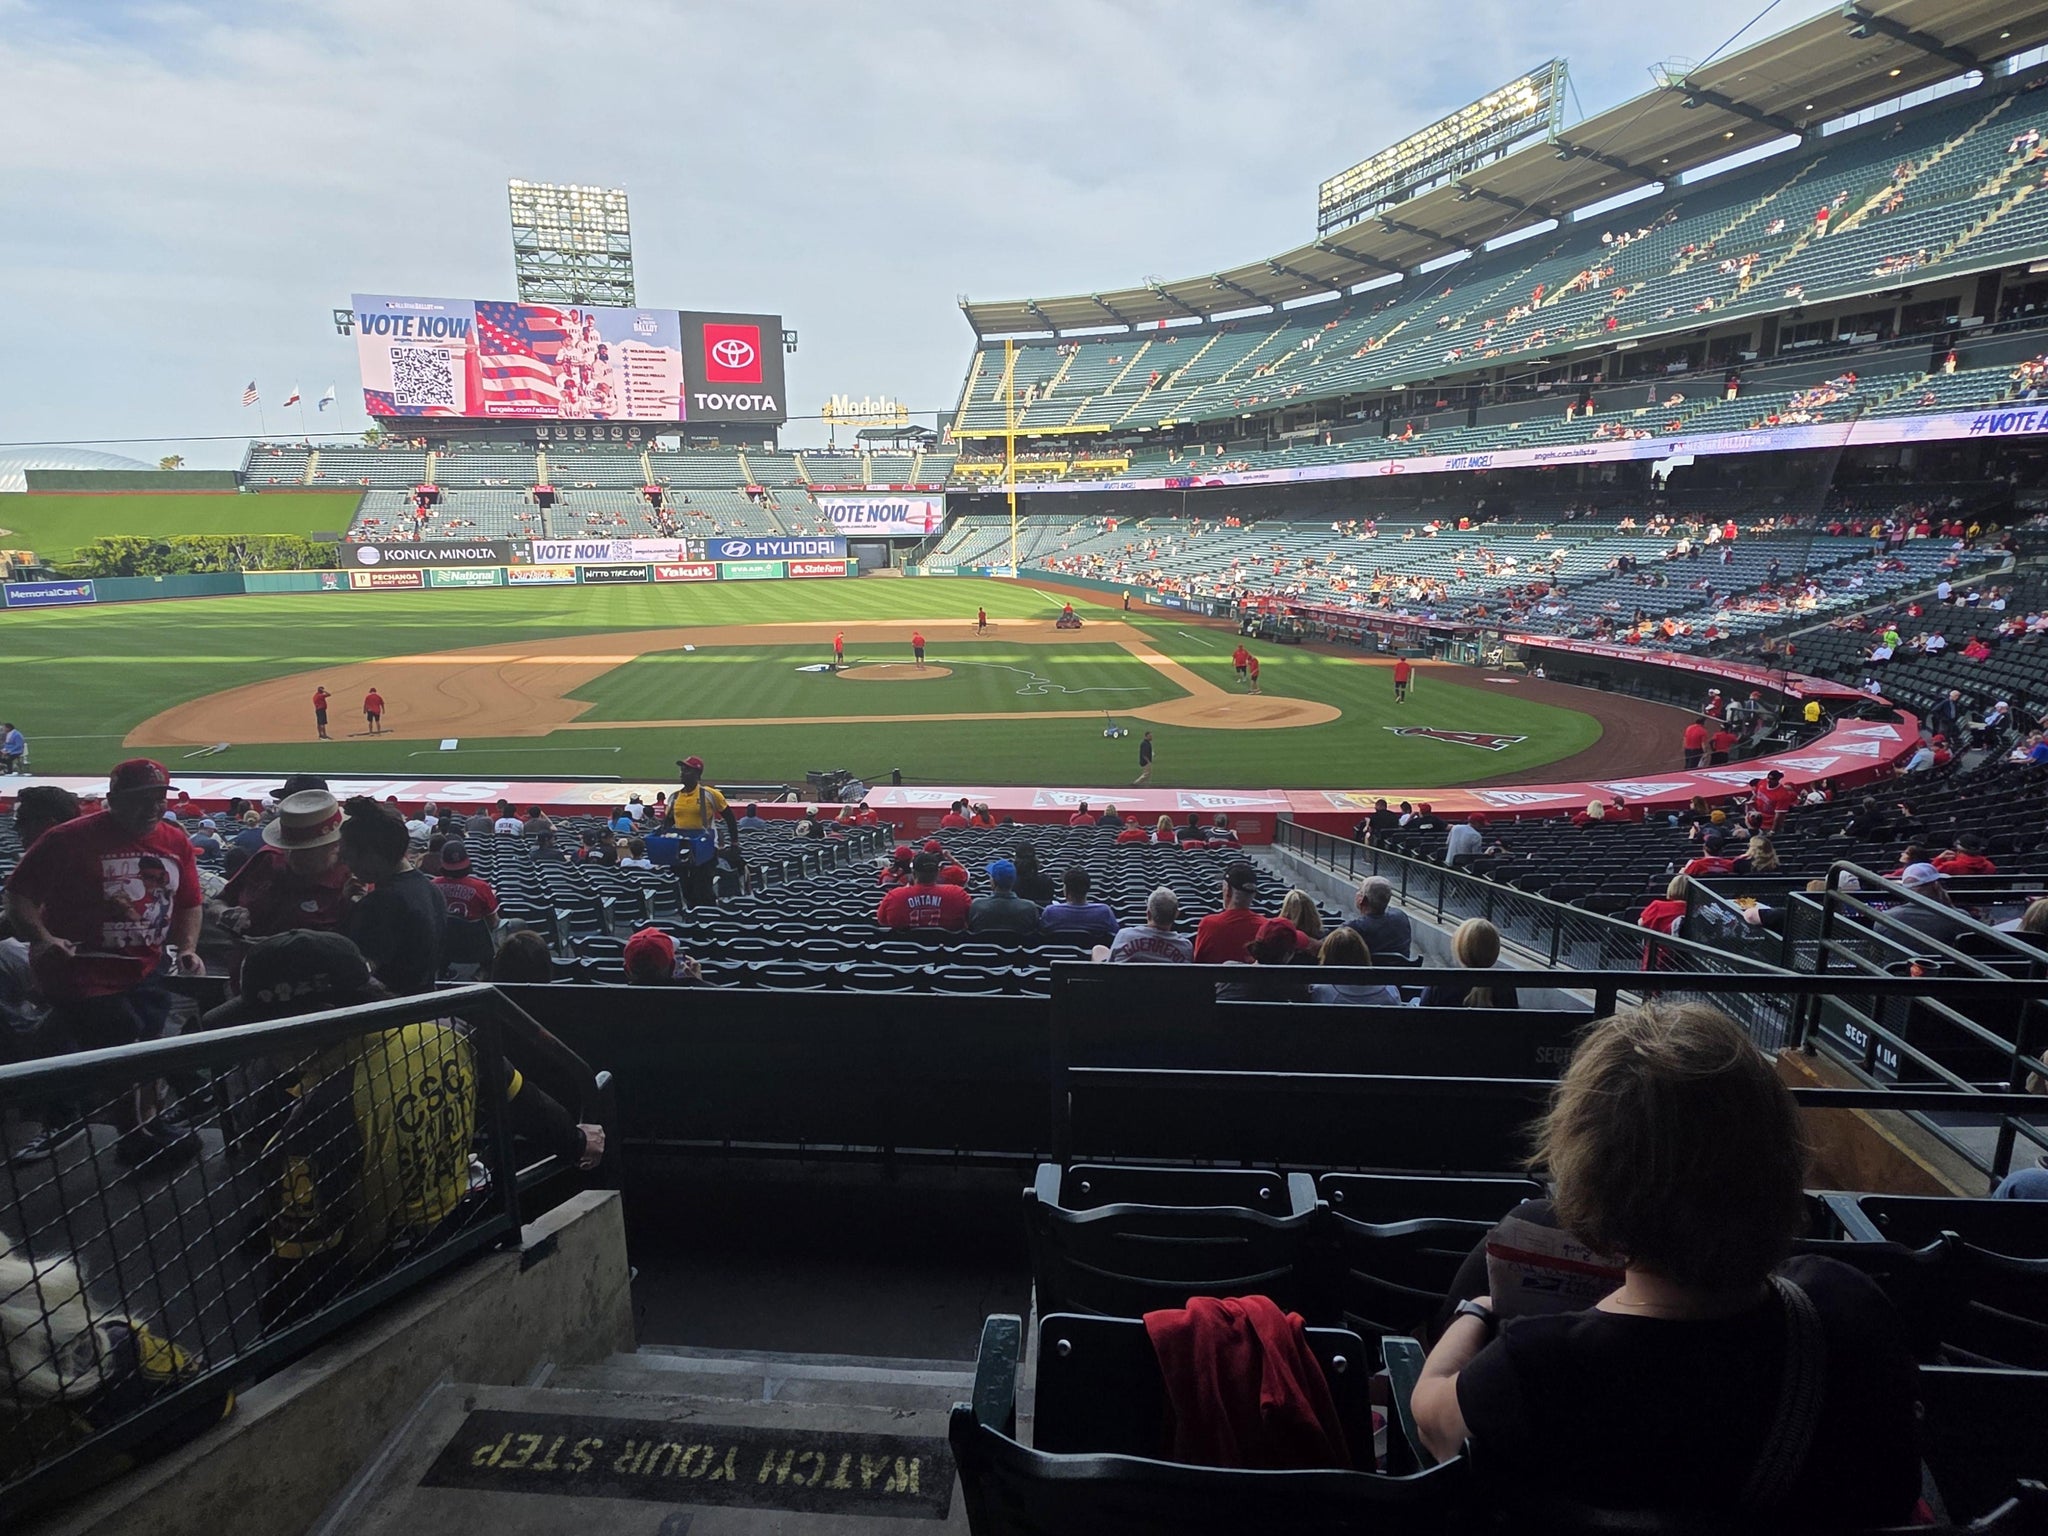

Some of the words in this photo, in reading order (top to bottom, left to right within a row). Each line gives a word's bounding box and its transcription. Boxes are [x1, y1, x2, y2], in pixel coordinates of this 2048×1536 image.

[360, 313, 414, 336] VOTE
[417, 316, 471, 338] NOW
[634, 323, 658, 333] BALLOT
[694, 393, 777, 411] TOYOTA
[832, 394, 897, 417] Modelo
[1969, 411, 2038, 436] #VOTE
[1468, 455, 1494, 468] ANGELS
[1533, 448, 1598, 461] angels.com/allstar
[824, 505, 865, 523] VOTE
[867, 504, 910, 522] NOW
[384, 550, 437, 560] KONICA
[440, 548, 496, 560] MINOLTA
[536, 544, 572, 560] VOTE
[574, 544, 611, 559] NOW
[756, 540, 835, 555] HYUNDAI
[451, 571, 494, 581] National
[586, 570, 609, 578] NITTO
[610, 569, 645, 577] TIRE.COM
[660, 566, 713, 578] Yakult
[10, 588, 78, 599] MemorialCare
[908, 895, 942, 908] OHTANI
[1845, 1023, 1868, 1048] SECT
[1883, 1048, 1897, 1068] 114
[395, 1058, 465, 1134] CSC
[469, 1431, 603, 1473] STEP
[613, 1439, 738, 1483] YOUR
[758, 1448, 922, 1495] WATCH
